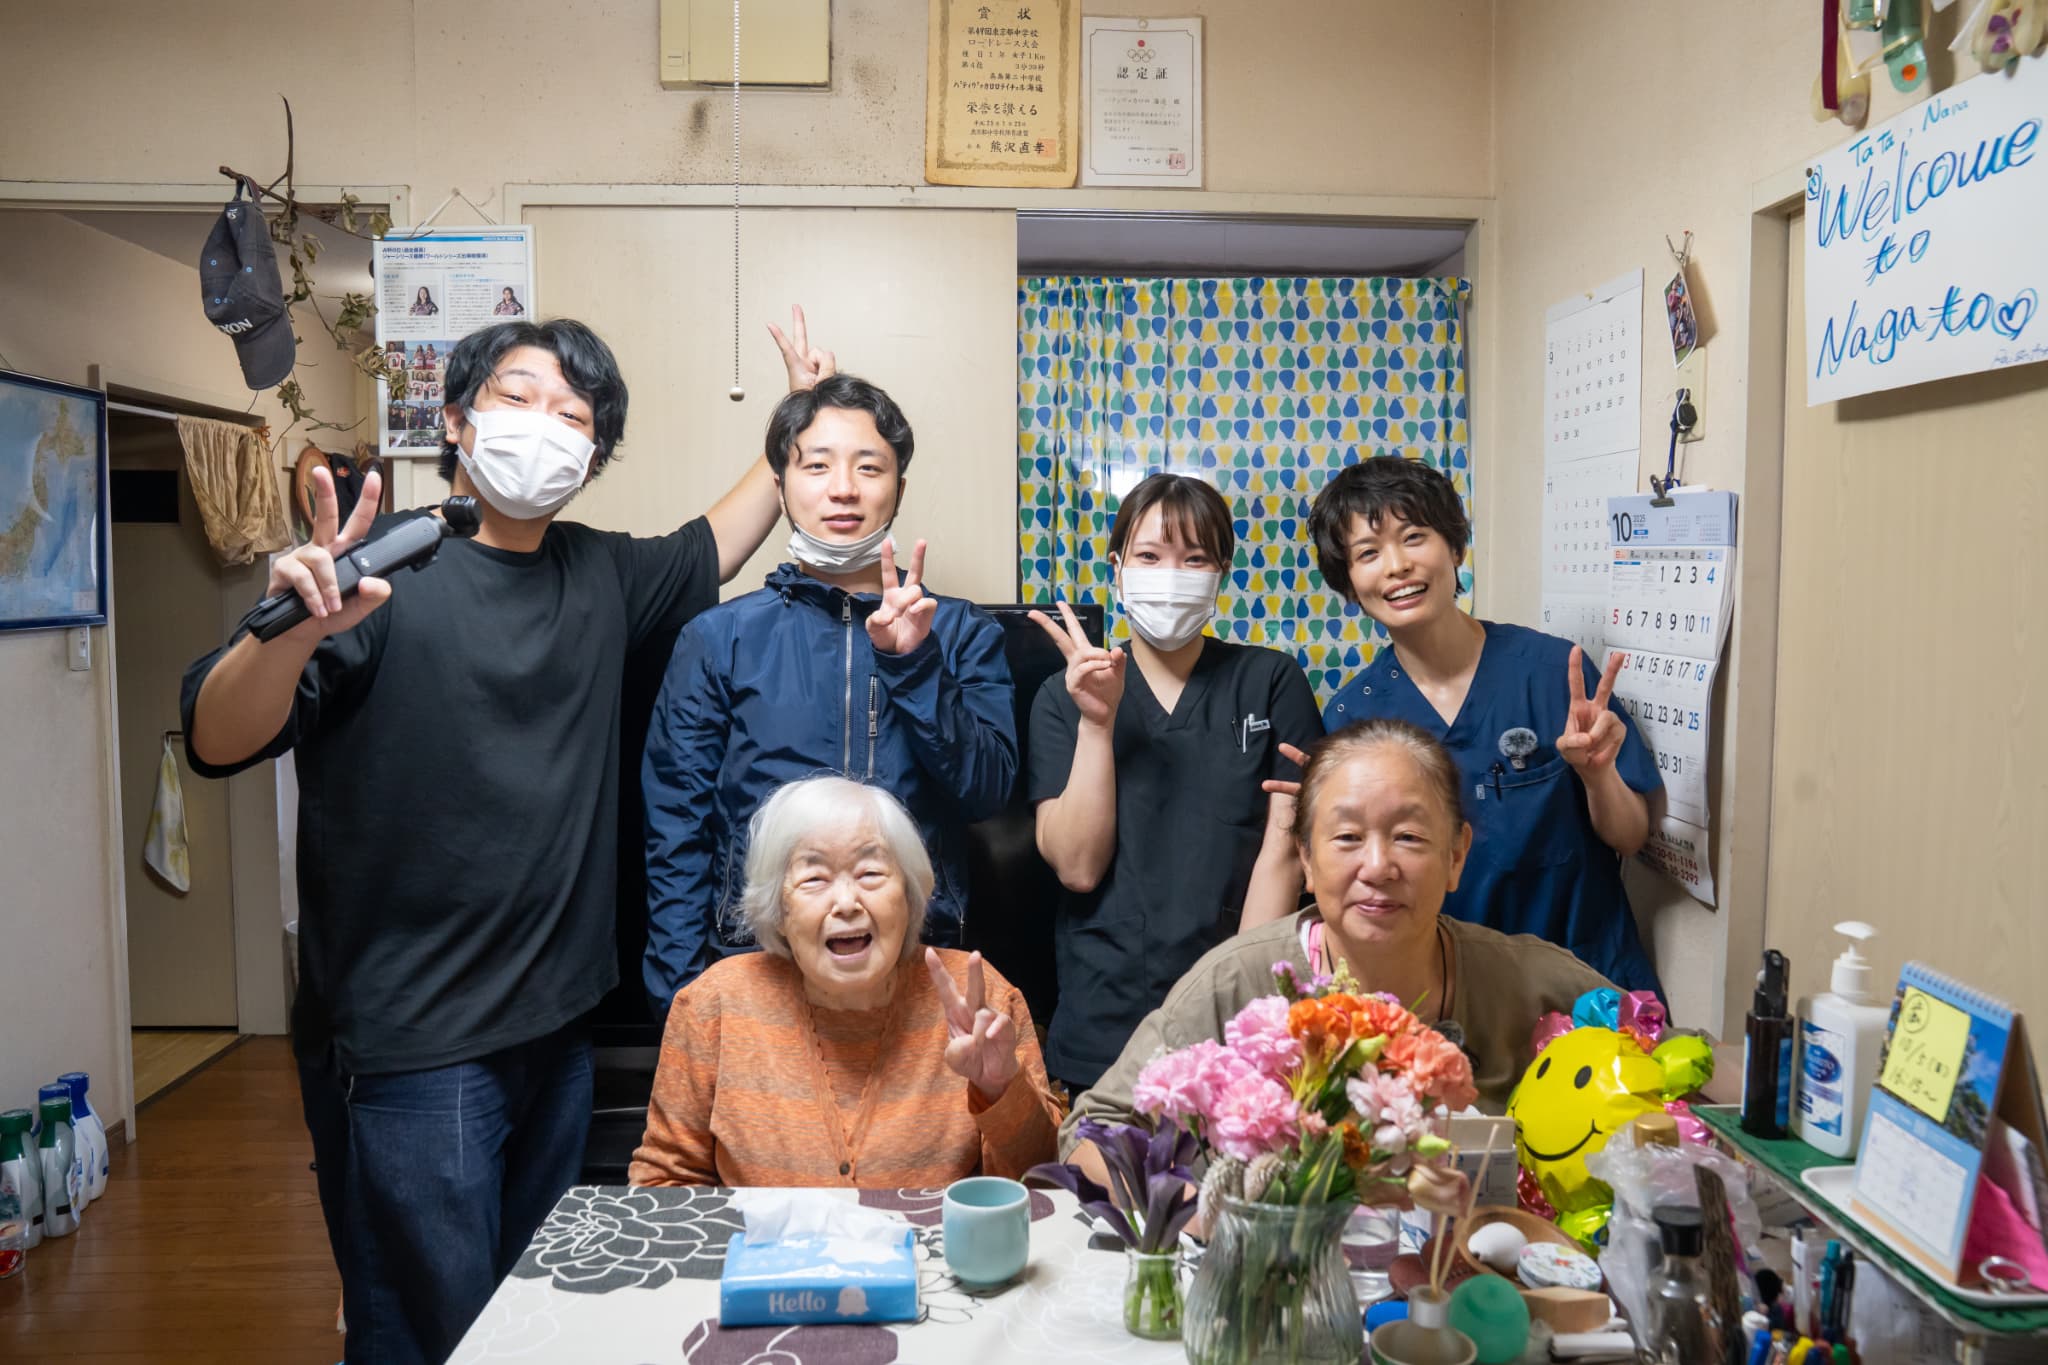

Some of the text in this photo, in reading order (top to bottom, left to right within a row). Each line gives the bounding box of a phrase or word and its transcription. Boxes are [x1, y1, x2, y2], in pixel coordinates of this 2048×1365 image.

[968, 39, 1039, 48] ロードレース大会
[1117, 66, 1168, 79] 認定証
[1819, 118, 2043, 248] Welcome
[1864, 230, 1931, 286] to
[1612, 512, 1632, 542] 10
[1661, 565, 1665, 583] 1
[1673, 566, 1681, 583] 2
[1689, 566, 1697, 584] 3
[1706, 566, 1715, 584] 4
[1613, 609, 1710, 634] 5 6 7 8 9 10 11
[1634, 655, 1645, 672] 14
[1648, 657, 1660, 674] 15
[1663, 659, 1674, 677] 16
[1678, 661, 1691, 679] 17
[1693, 663, 1706, 682] 18
[1630, 699, 1638, 718] 21
[1643, 702, 1653, 720] 22
[1658, 705, 1668, 724] 23
[1673, 708, 1683, 727] 24
[1688, 711, 1699, 731] 25
[1658, 751, 1668, 770] 30
[1672, 756, 1682, 774] 31
[768, 1290, 826, 1313] Hello
